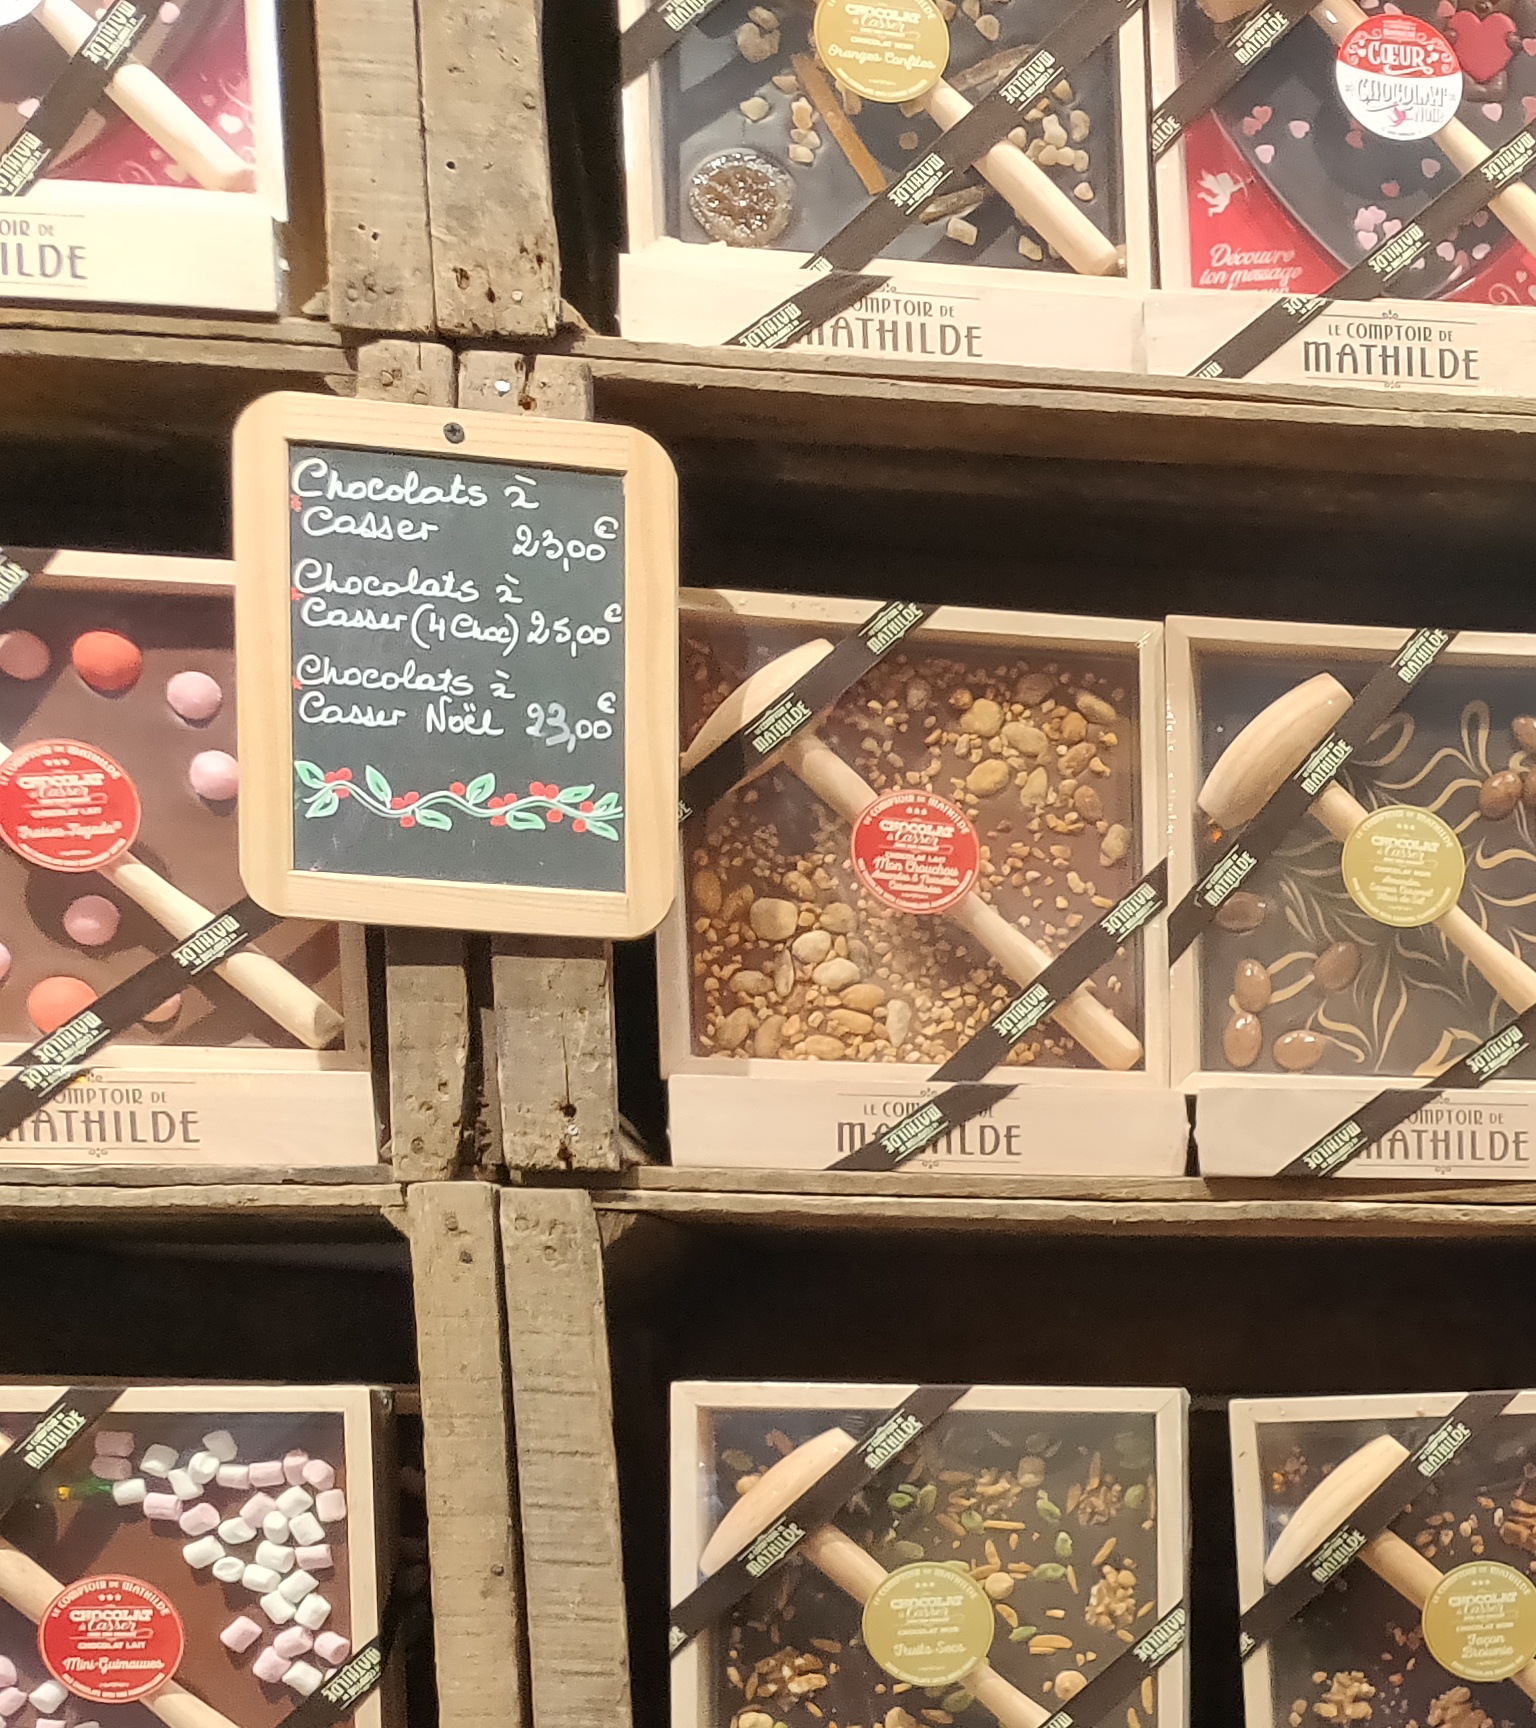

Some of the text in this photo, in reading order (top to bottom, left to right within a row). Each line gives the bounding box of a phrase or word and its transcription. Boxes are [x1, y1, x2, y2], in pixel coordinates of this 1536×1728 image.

[828, 43, 882, 65] Oranges
[1234, 9, 1290, 65] MATHILDE
[999, 50, 1056, 105] MATHILDE
[1357, 78, 1449, 107] CHOCOLAT
[1210, 243, 1296, 271] Découvre
[1230, 264, 1303, 290] message
[1328, 322, 1453, 343] LE COMPTOIR DE
[1304, 341, 1480, 381] MATHILDE
[292, 457, 539, 509] Chocolats à
[302, 506, 439, 541] Casser
[294, 558, 523, 604] Chocolats à
[302, 597, 407, 630] Casser
[296, 654, 516, 699] Chocolats à
[299, 691, 406, 726] Casser
[426, 697, 504, 735] Noël
[23, 1407, 87, 1470] MATHILDE
[864, 1416, 923, 1472] MATHILDE
[69, 1609, 153, 1622] CHOCOLAT
[122, 1581, 171, 1616] MATHILDE
